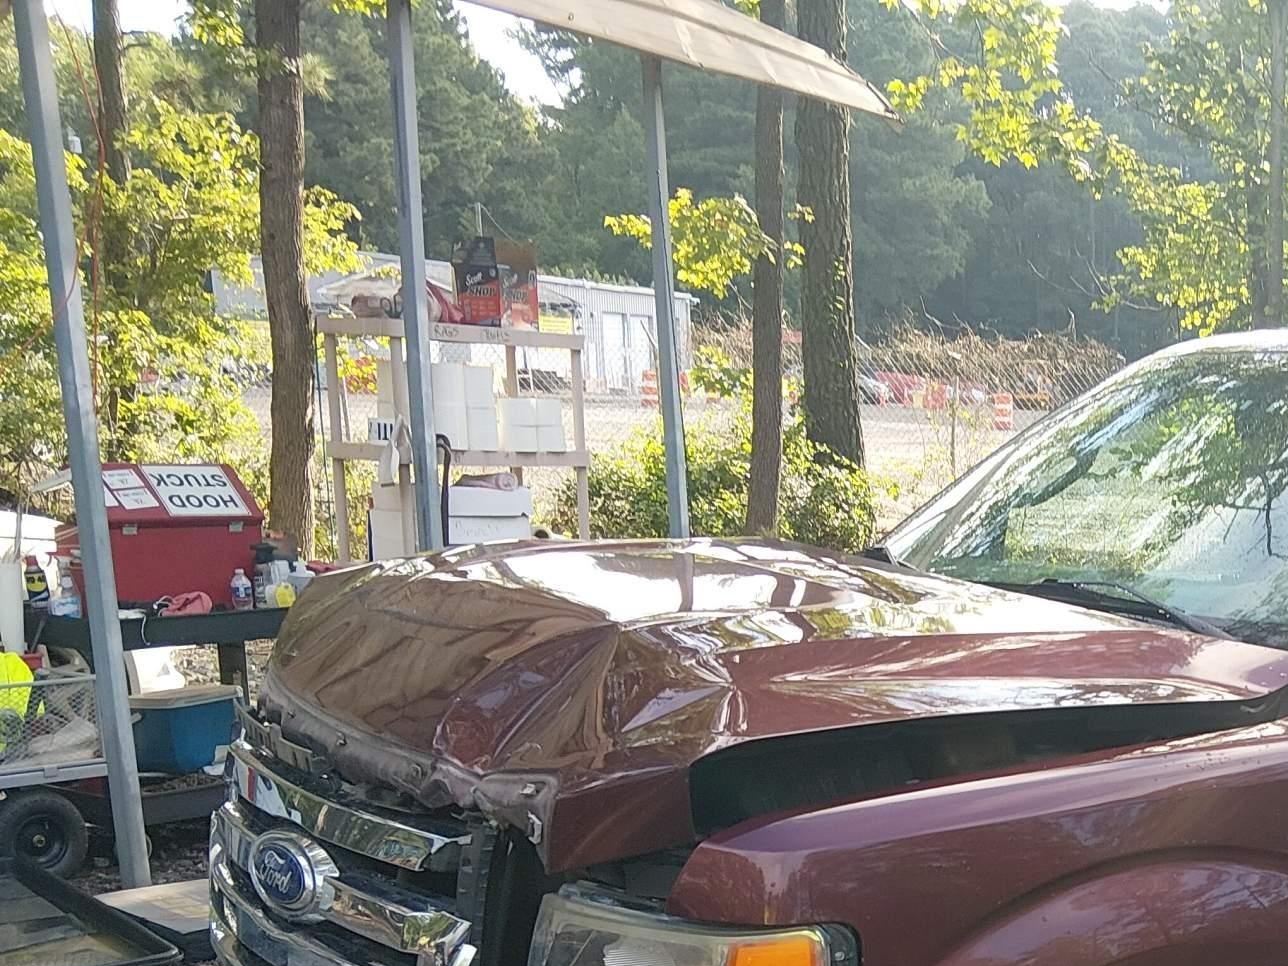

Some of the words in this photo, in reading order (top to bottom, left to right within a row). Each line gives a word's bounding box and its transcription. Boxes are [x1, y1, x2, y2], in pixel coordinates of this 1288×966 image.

[150, 473, 228, 488] STUCK
[168, 493, 240, 509] HOOD
[259, 850, 292, 894] Ford
